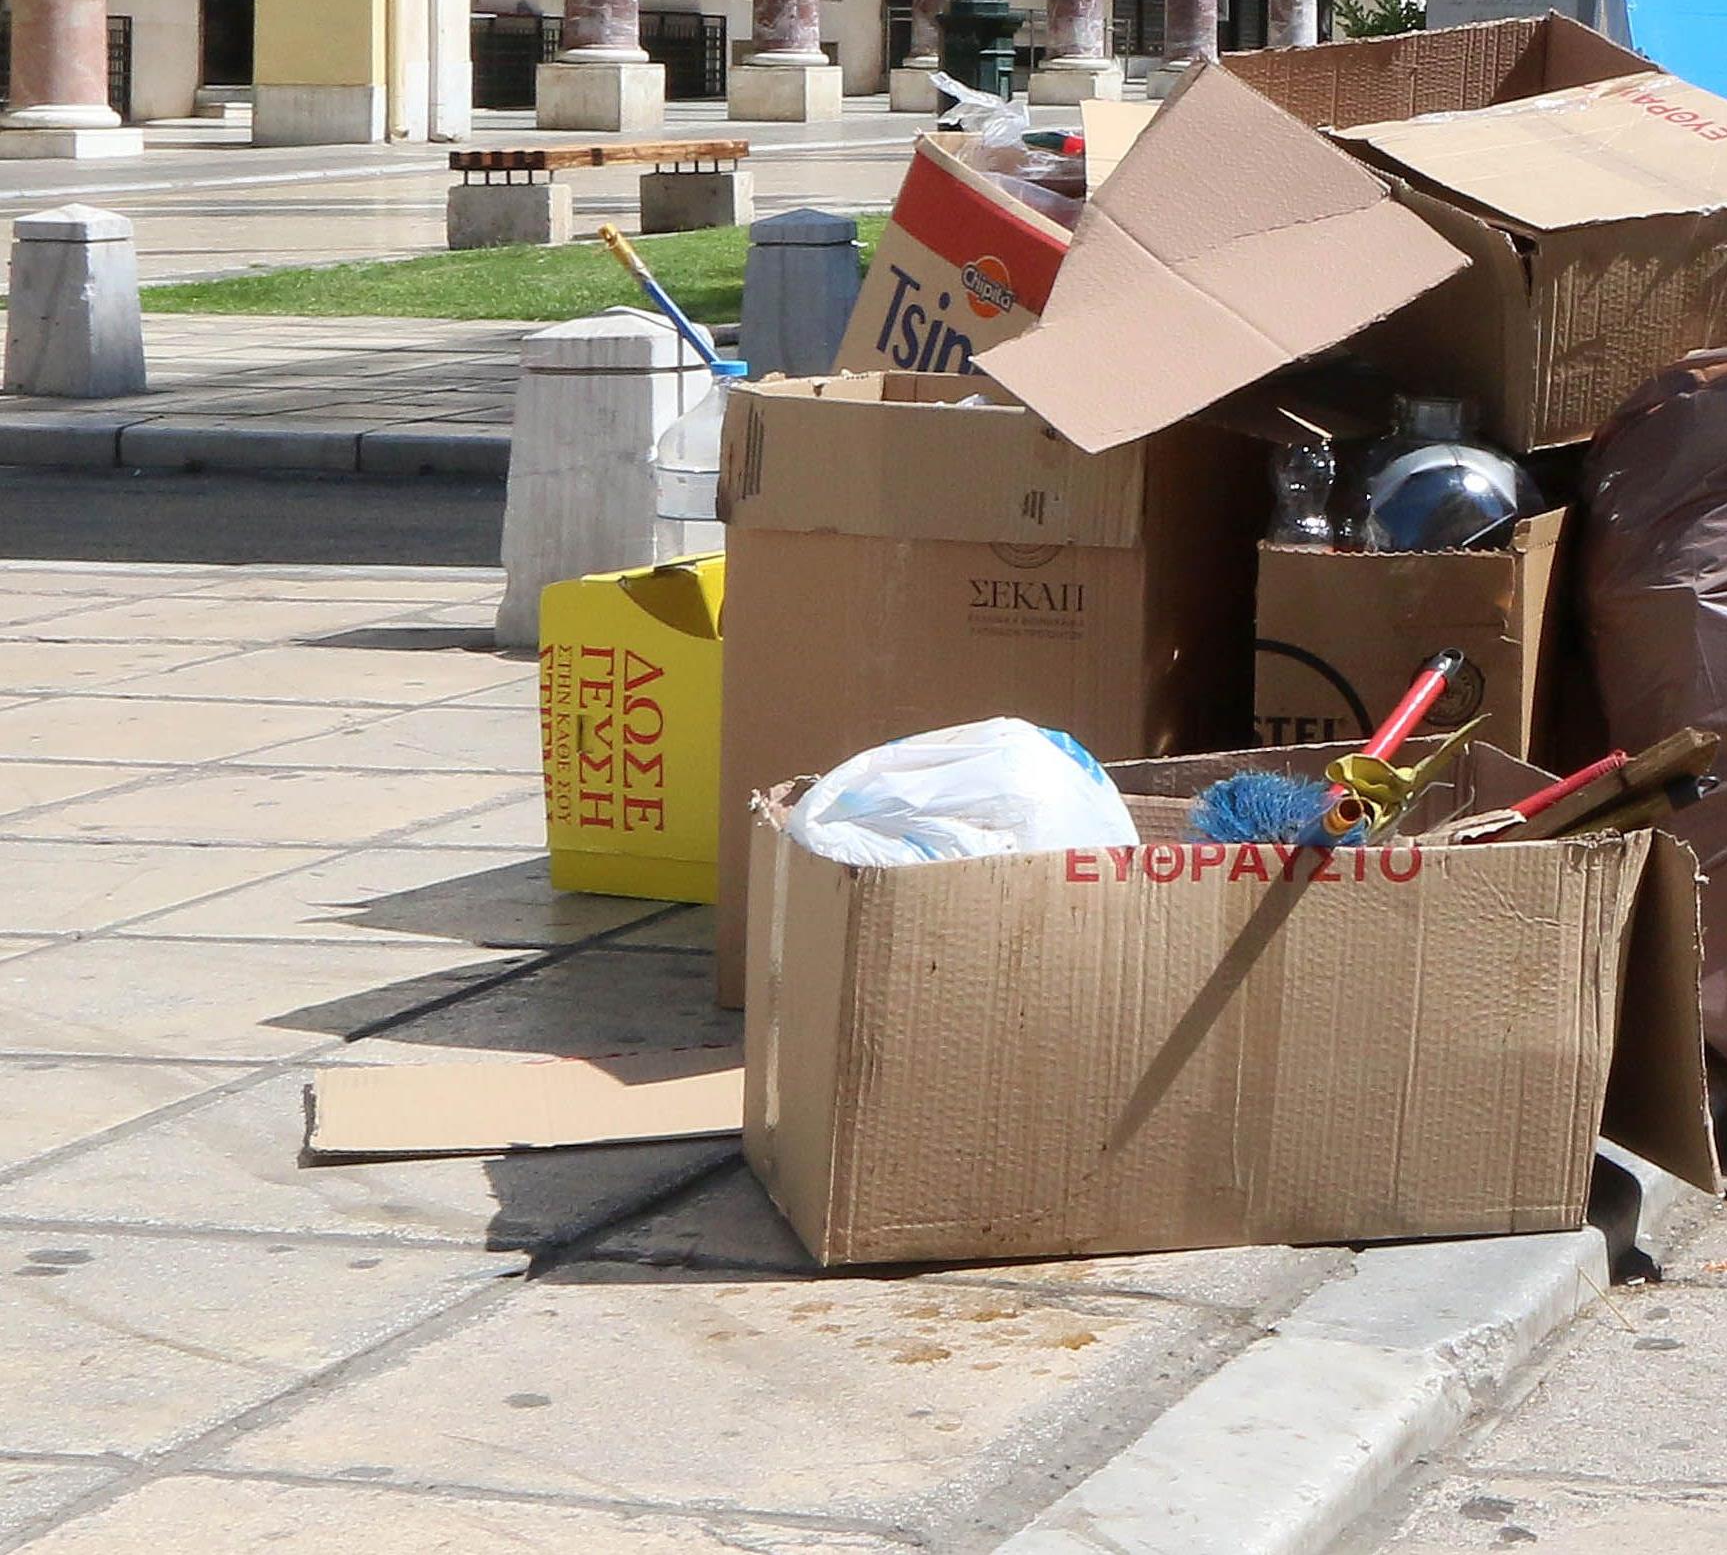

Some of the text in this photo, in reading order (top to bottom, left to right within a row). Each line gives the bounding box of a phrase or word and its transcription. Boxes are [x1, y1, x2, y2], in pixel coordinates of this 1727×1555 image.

[963, 266, 1014, 311] Chipita
[556, 644, 573, 826] ΣΤΗΝ ΚΑΘΕ ΣΟΥ
[579, 644, 616, 830] ΓΕΥΣΗ
[623, 649, 665, 832] ΔΩΣΕ
